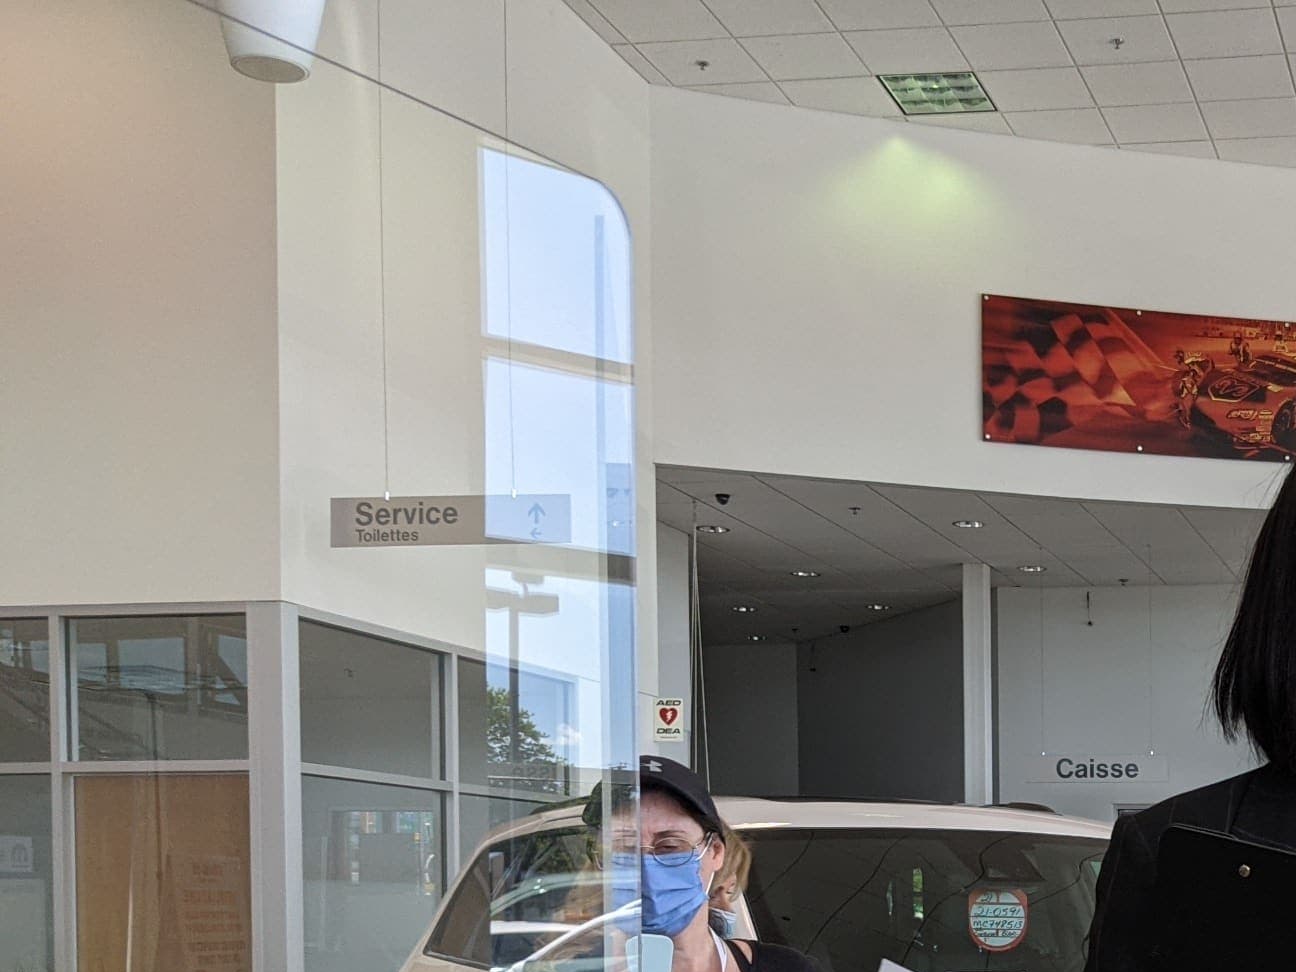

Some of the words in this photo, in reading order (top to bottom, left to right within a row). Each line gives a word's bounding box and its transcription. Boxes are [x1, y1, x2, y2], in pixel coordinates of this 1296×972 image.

[355, 501, 458, 526] Service
[356, 529, 419, 542] Toilettes
[1056, 758, 1139, 779] Caisse
